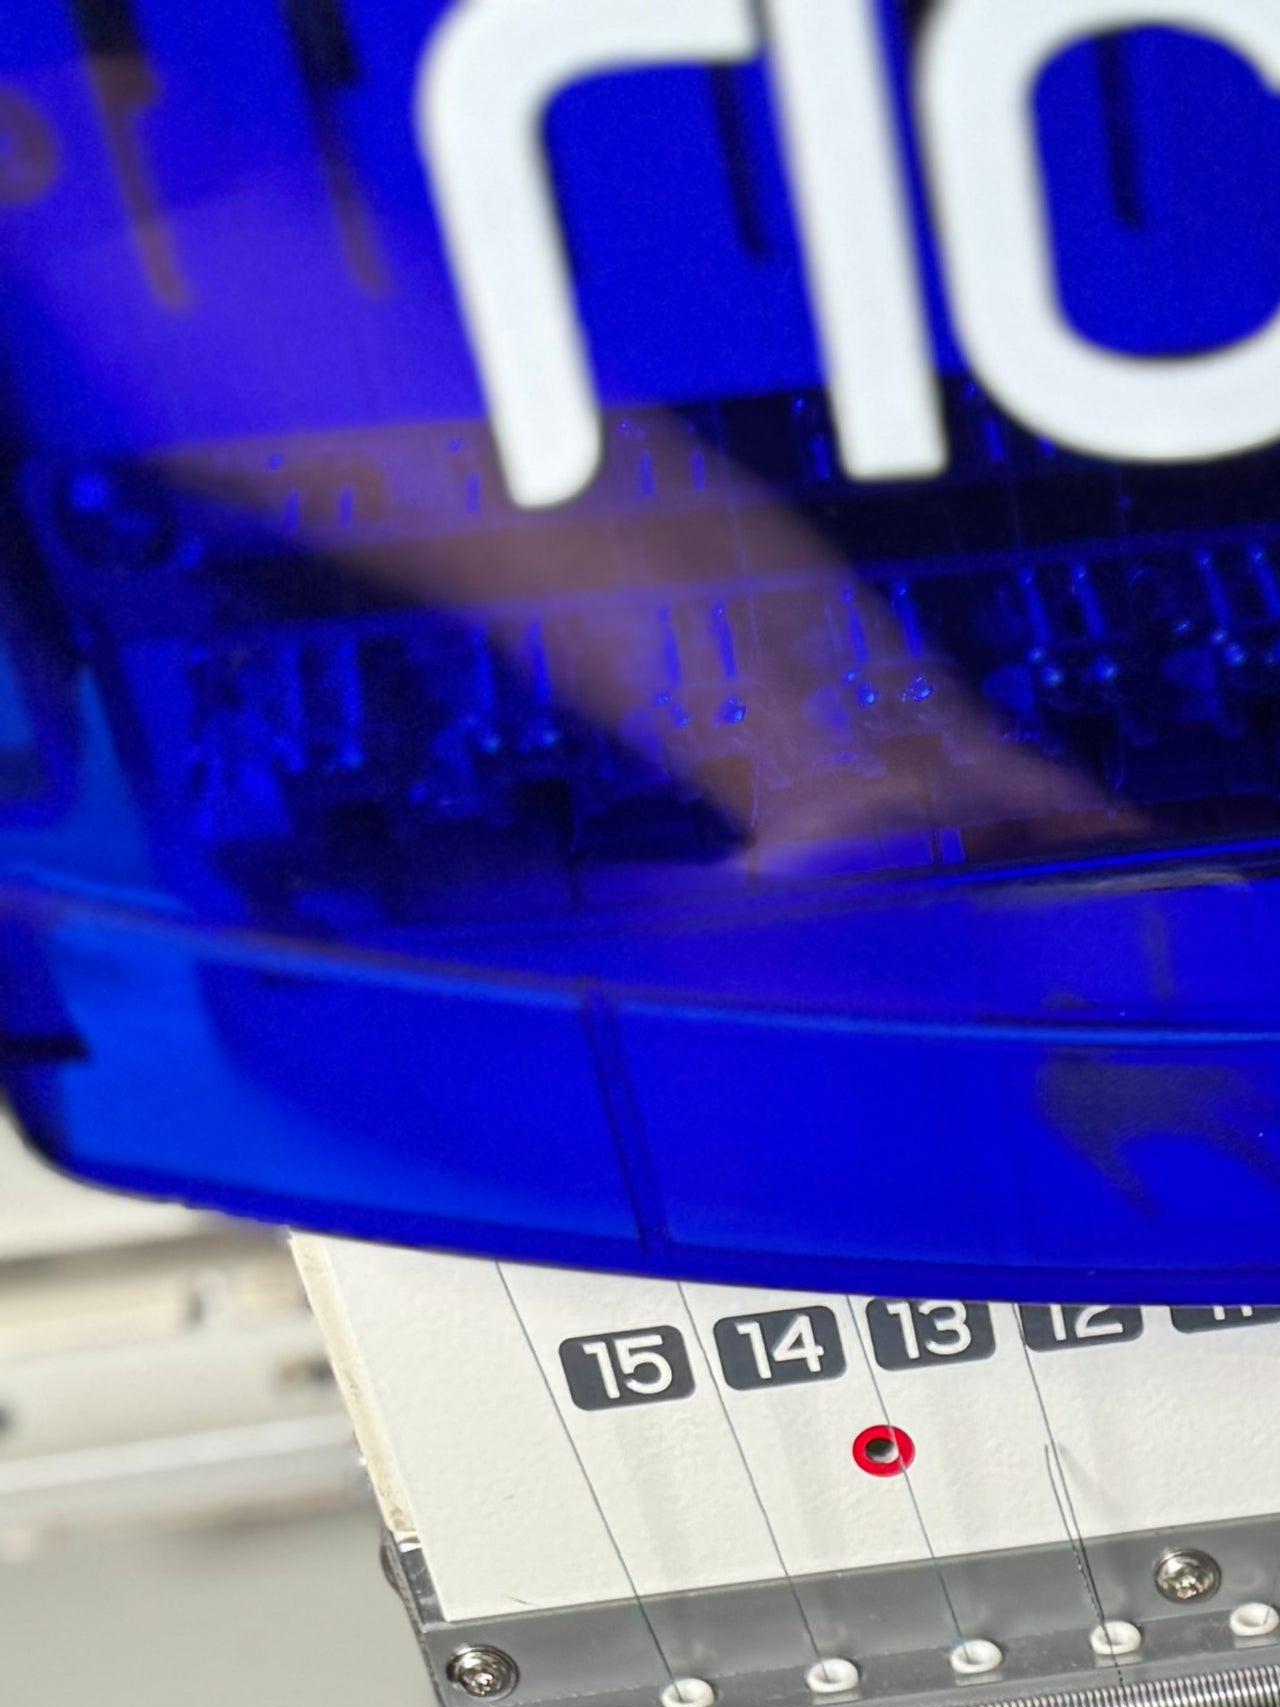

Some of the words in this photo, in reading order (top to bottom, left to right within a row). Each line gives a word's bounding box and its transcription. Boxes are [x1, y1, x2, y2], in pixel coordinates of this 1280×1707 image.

[581, 1333, 673, 1400] 15
[735, 1314, 825, 1381] 14
[885, 1300, 973, 1361] 13
